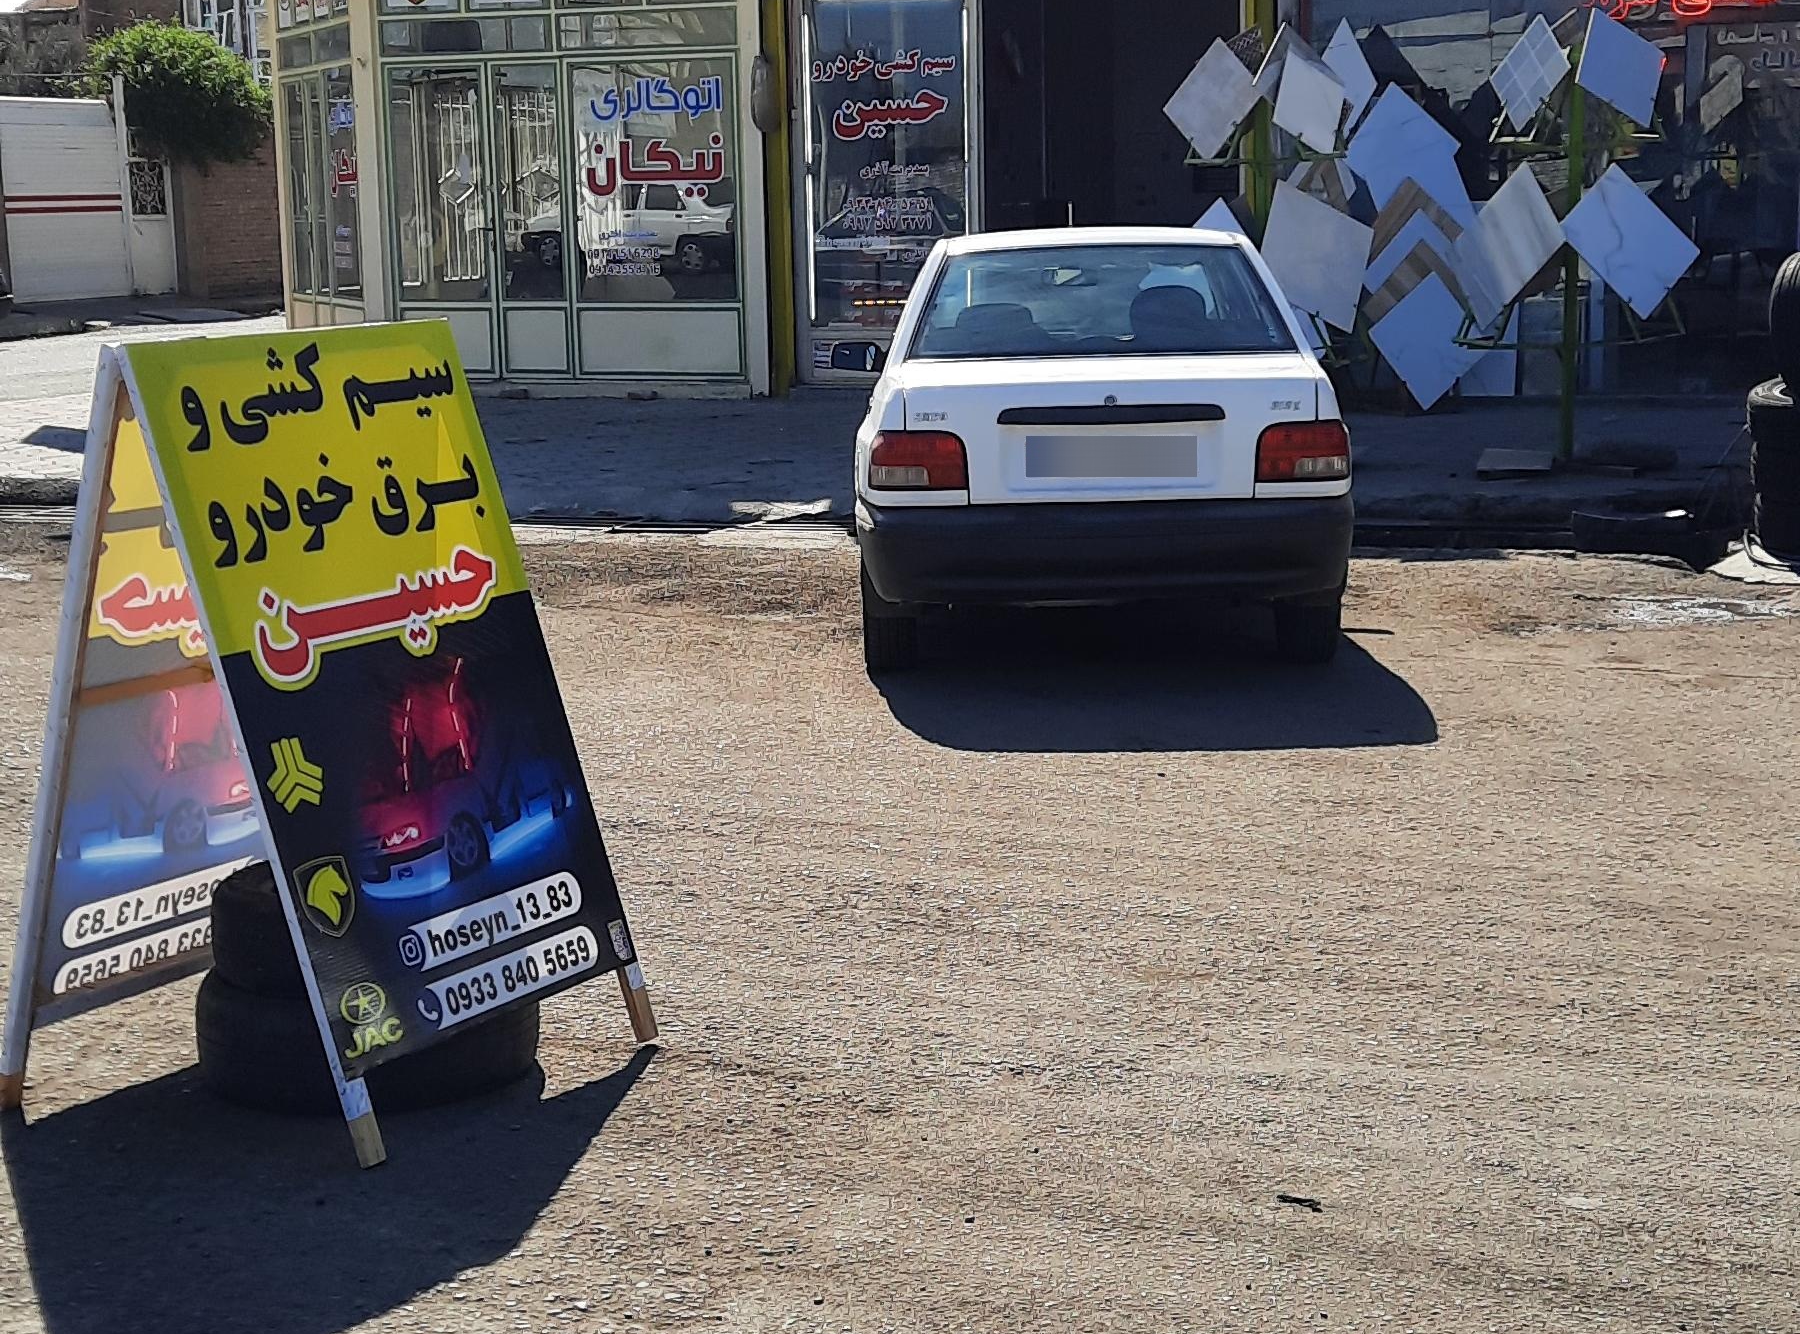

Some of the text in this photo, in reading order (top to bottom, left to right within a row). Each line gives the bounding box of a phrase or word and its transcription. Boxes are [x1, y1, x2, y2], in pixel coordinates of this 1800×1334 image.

[588, 75, 722, 121] اتوگالری
[811, 49, 956, 82] سیم کشی خودرو
[833, 89, 949, 141] حسین
[586, 131, 723, 199] نیکان
[180, 341, 455, 453] سیم کشی و
[205, 452, 481, 569] برق خودرو
[256, 543, 498, 684] حسین
[427, 879, 573, 957] hoseyn_13_83
[445, 971, 498, 1016] 0933
[502, 954, 540, 994] 840
[543, 934, 591, 977] 5659
[343, 1016, 405, 1060] JAC
